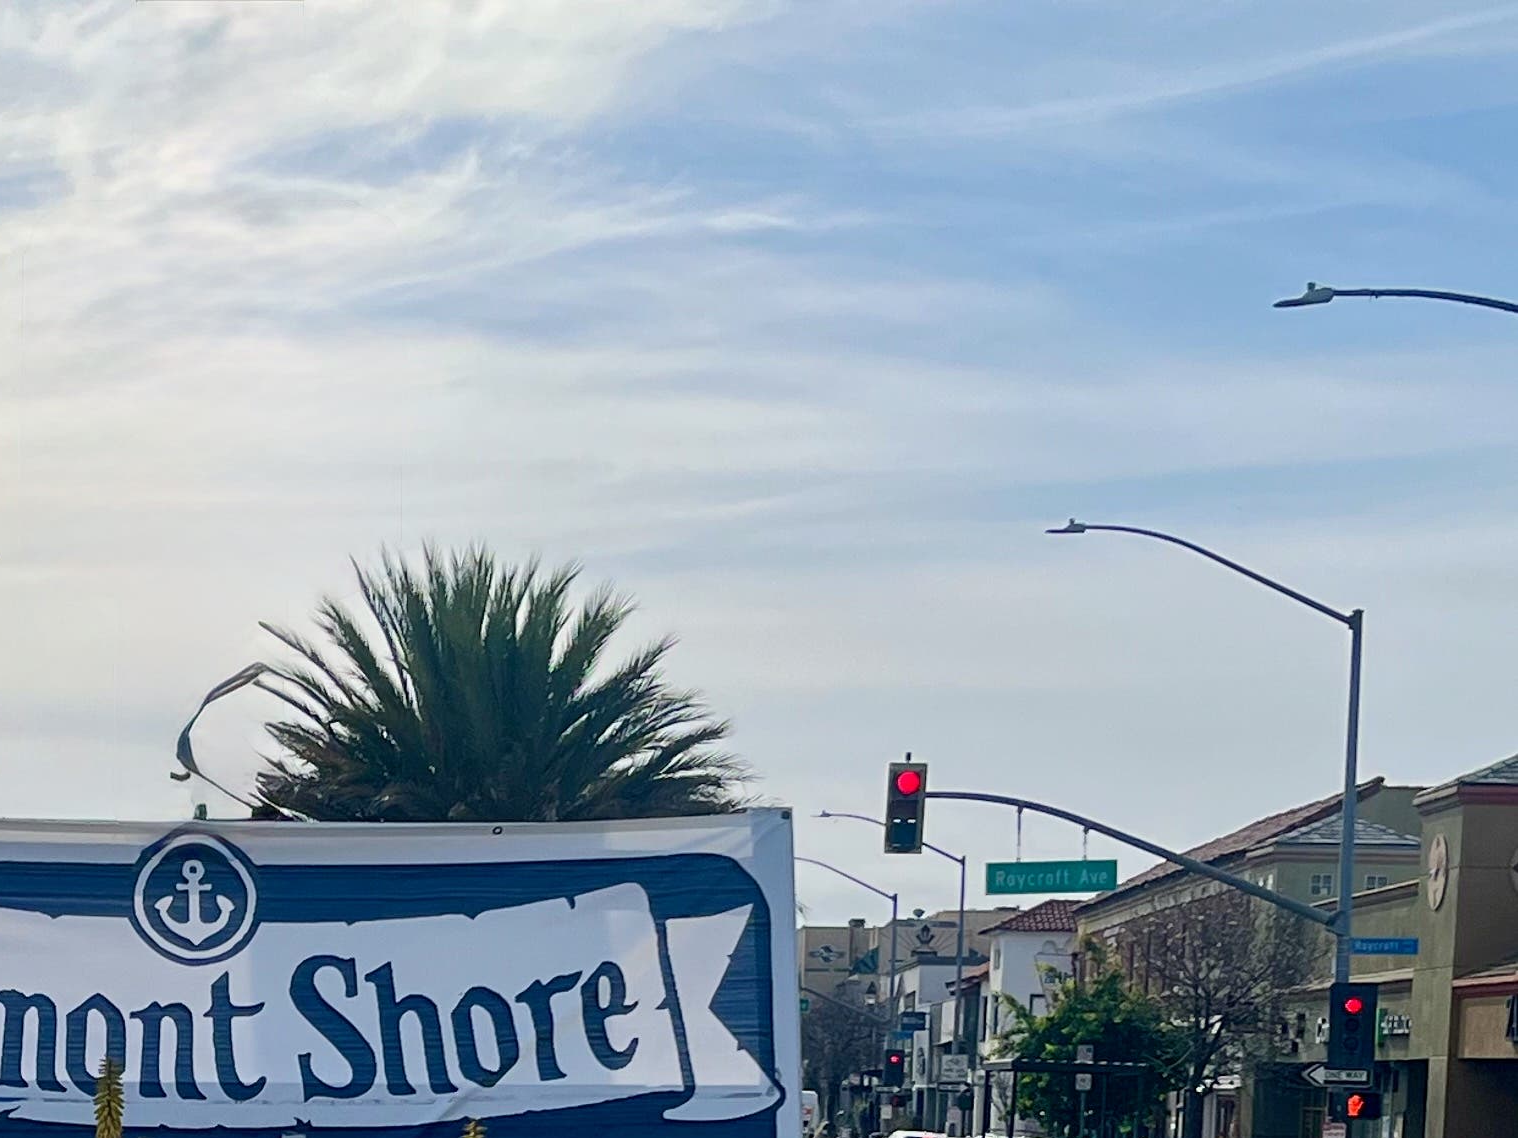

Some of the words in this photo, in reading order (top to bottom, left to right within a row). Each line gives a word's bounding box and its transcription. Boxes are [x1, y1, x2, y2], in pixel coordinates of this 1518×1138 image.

[995, 869, 1070, 889] Roycroft
[1078, 868, 1109, 885] Ave
[289, 954, 640, 1103] Shore
